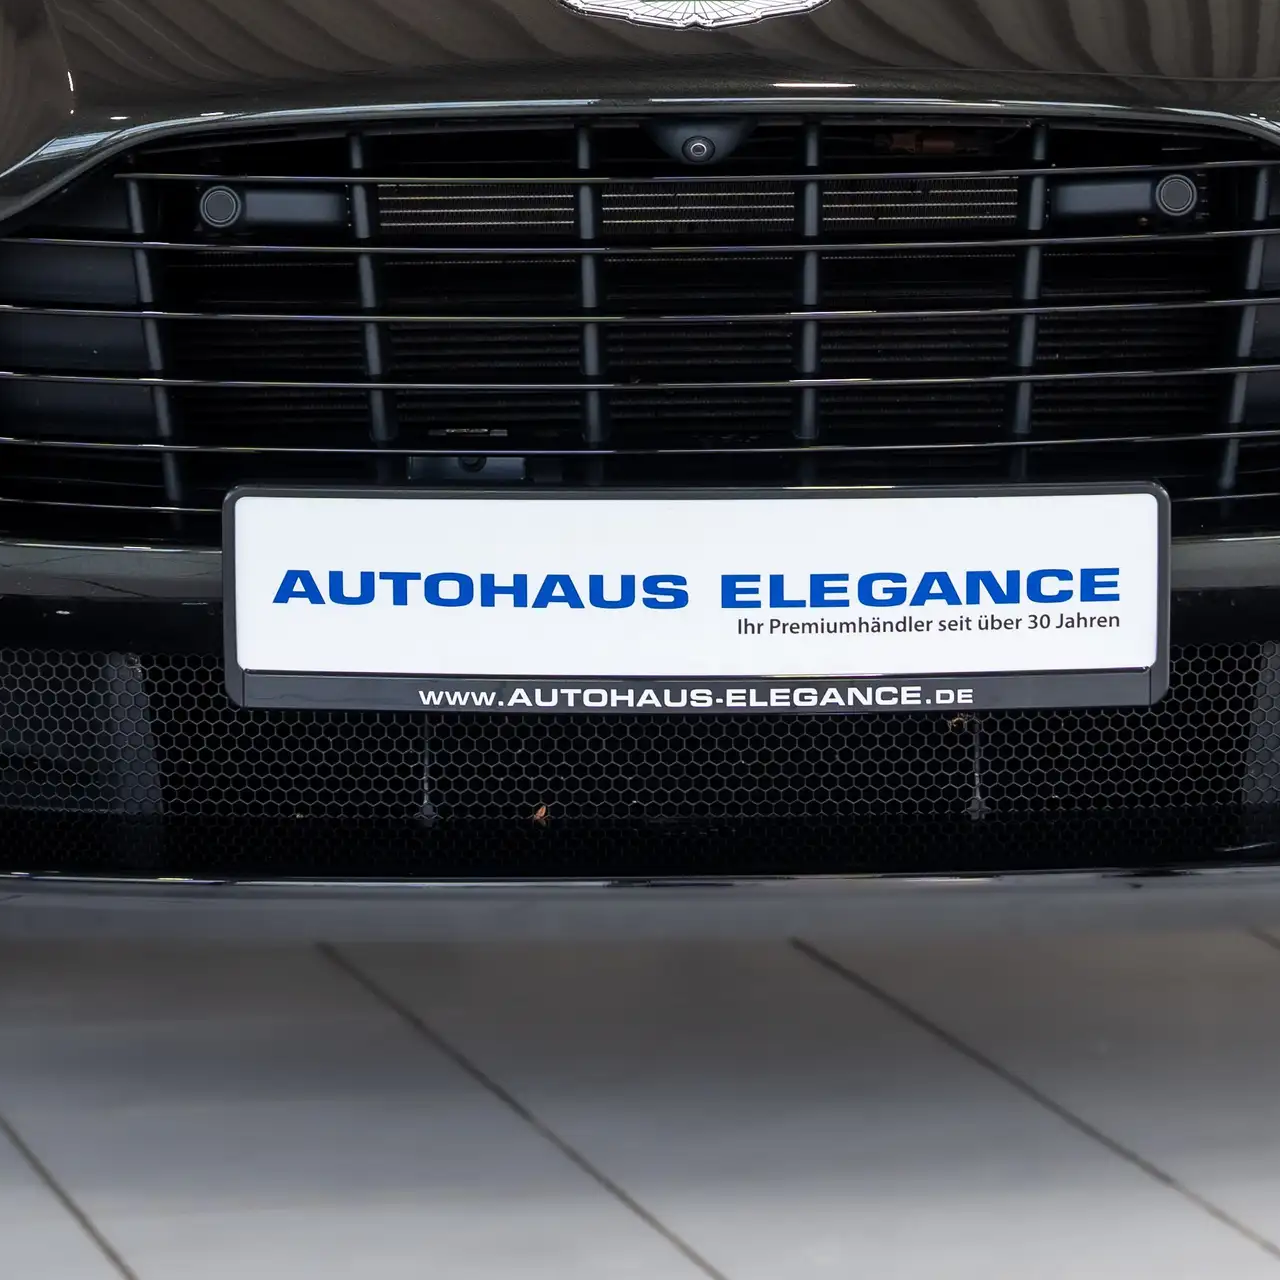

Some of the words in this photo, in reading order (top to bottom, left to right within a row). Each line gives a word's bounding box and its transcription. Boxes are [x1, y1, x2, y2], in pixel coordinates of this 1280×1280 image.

[272, 569, 689, 610] AUTOHAUS
[721, 567, 1121, 609] ELEGANCE
[737, 617, 764, 635] Ihr
[769, 616, 933, 635] Premiumhändler
[938, 615, 972, 632] seit
[978, 614, 1023, 632] über
[1027, 613, 1051, 631] 30
[1055, 612, 1121, 630] Jahren
